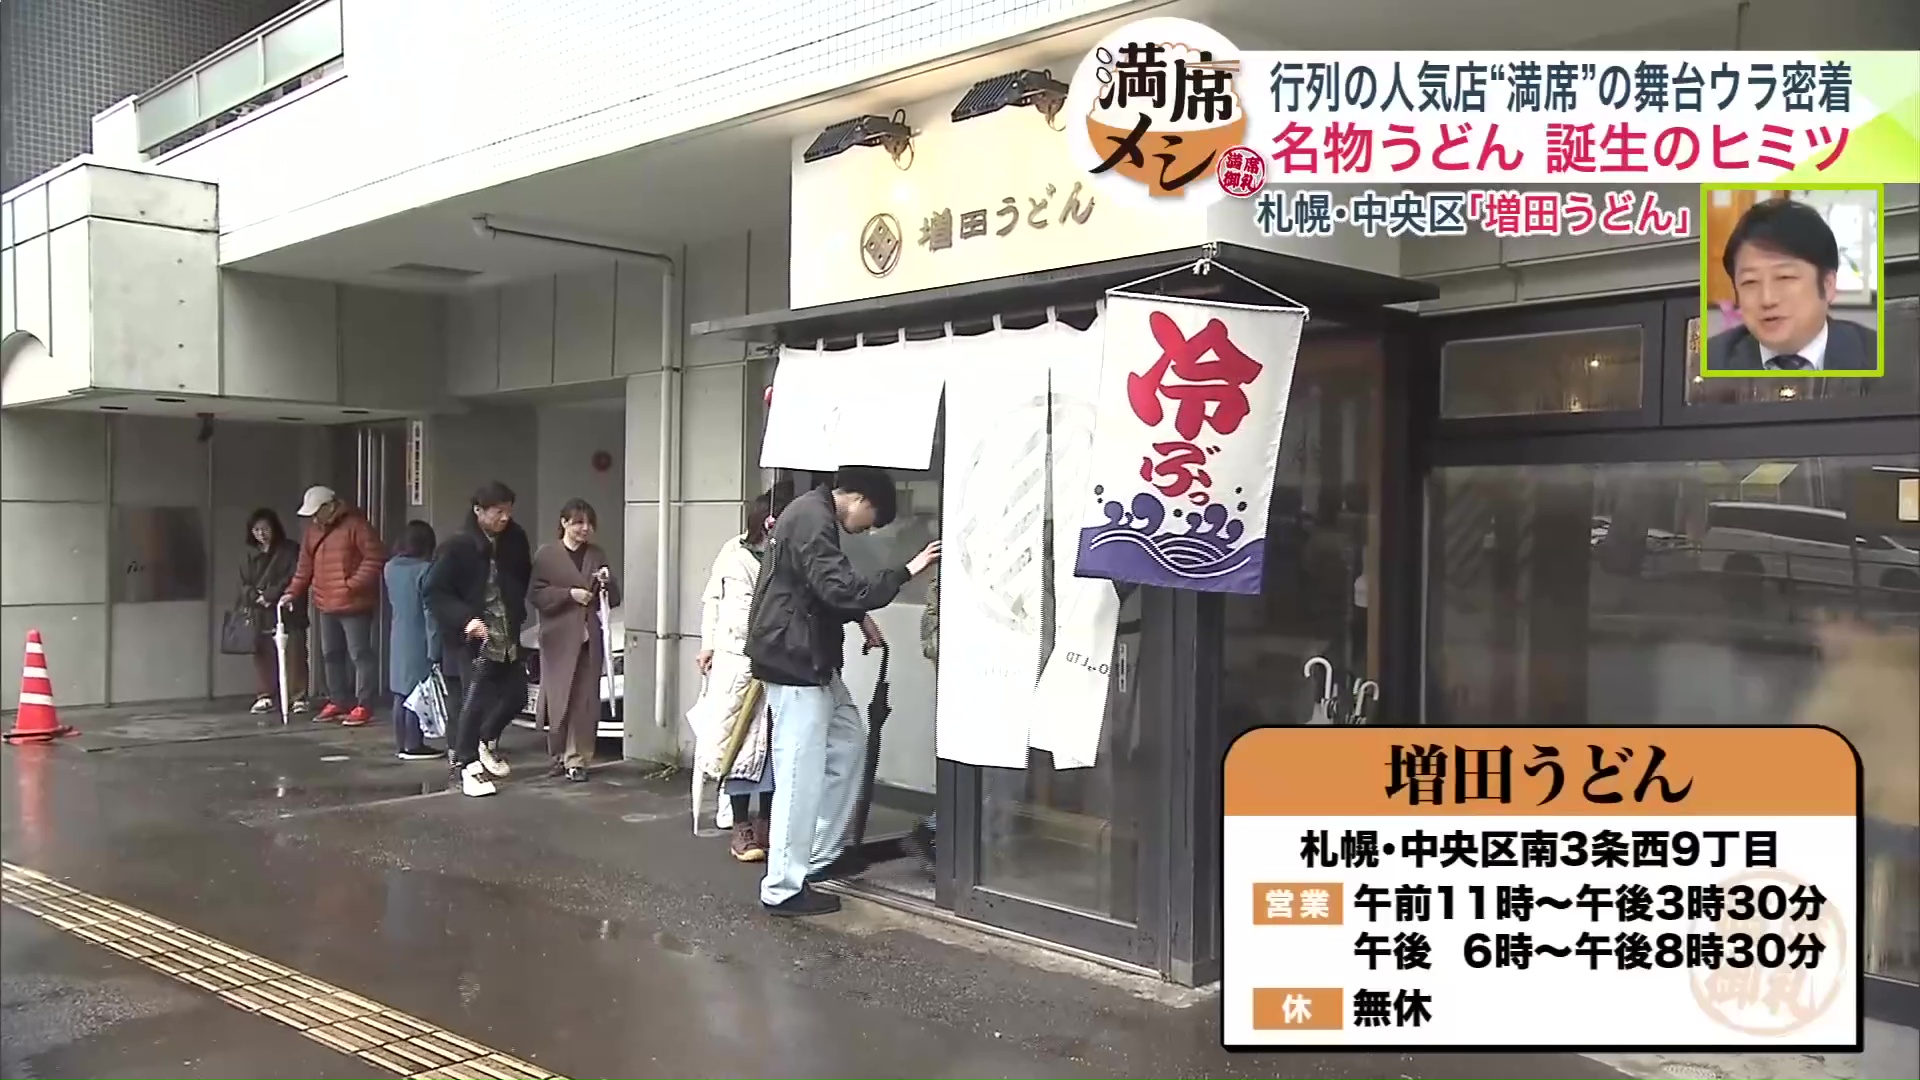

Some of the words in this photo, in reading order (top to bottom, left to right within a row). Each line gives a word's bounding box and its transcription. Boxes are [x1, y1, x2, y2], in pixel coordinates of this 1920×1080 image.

[918, 181, 1096, 253] 増田うどん
